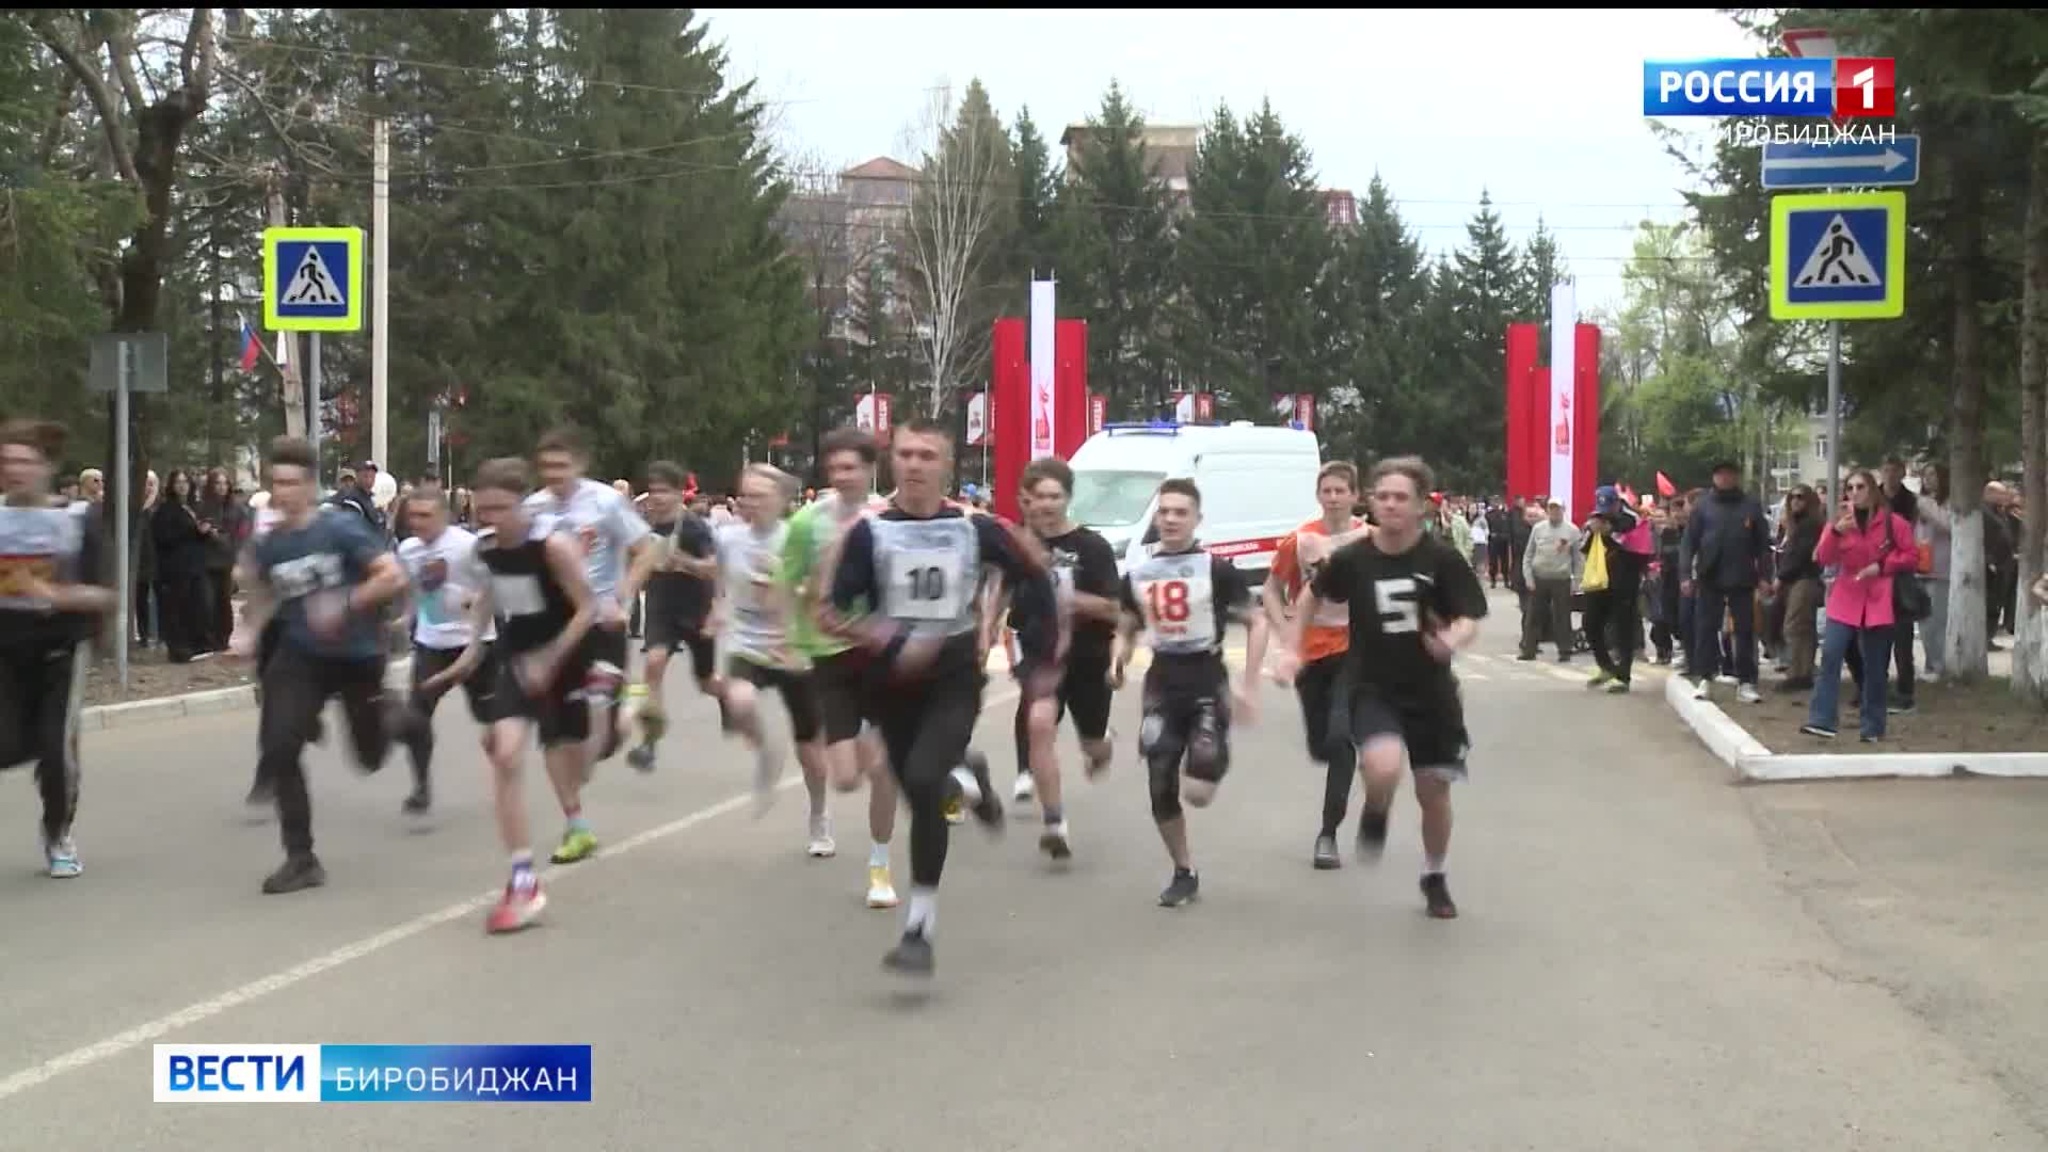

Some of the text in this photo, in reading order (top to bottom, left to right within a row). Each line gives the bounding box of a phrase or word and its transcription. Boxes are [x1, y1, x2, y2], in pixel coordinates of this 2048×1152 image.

[905, 566, 943, 600] 10
[1145, 581, 1190, 622] 18
[1374, 579, 1419, 633] 5
